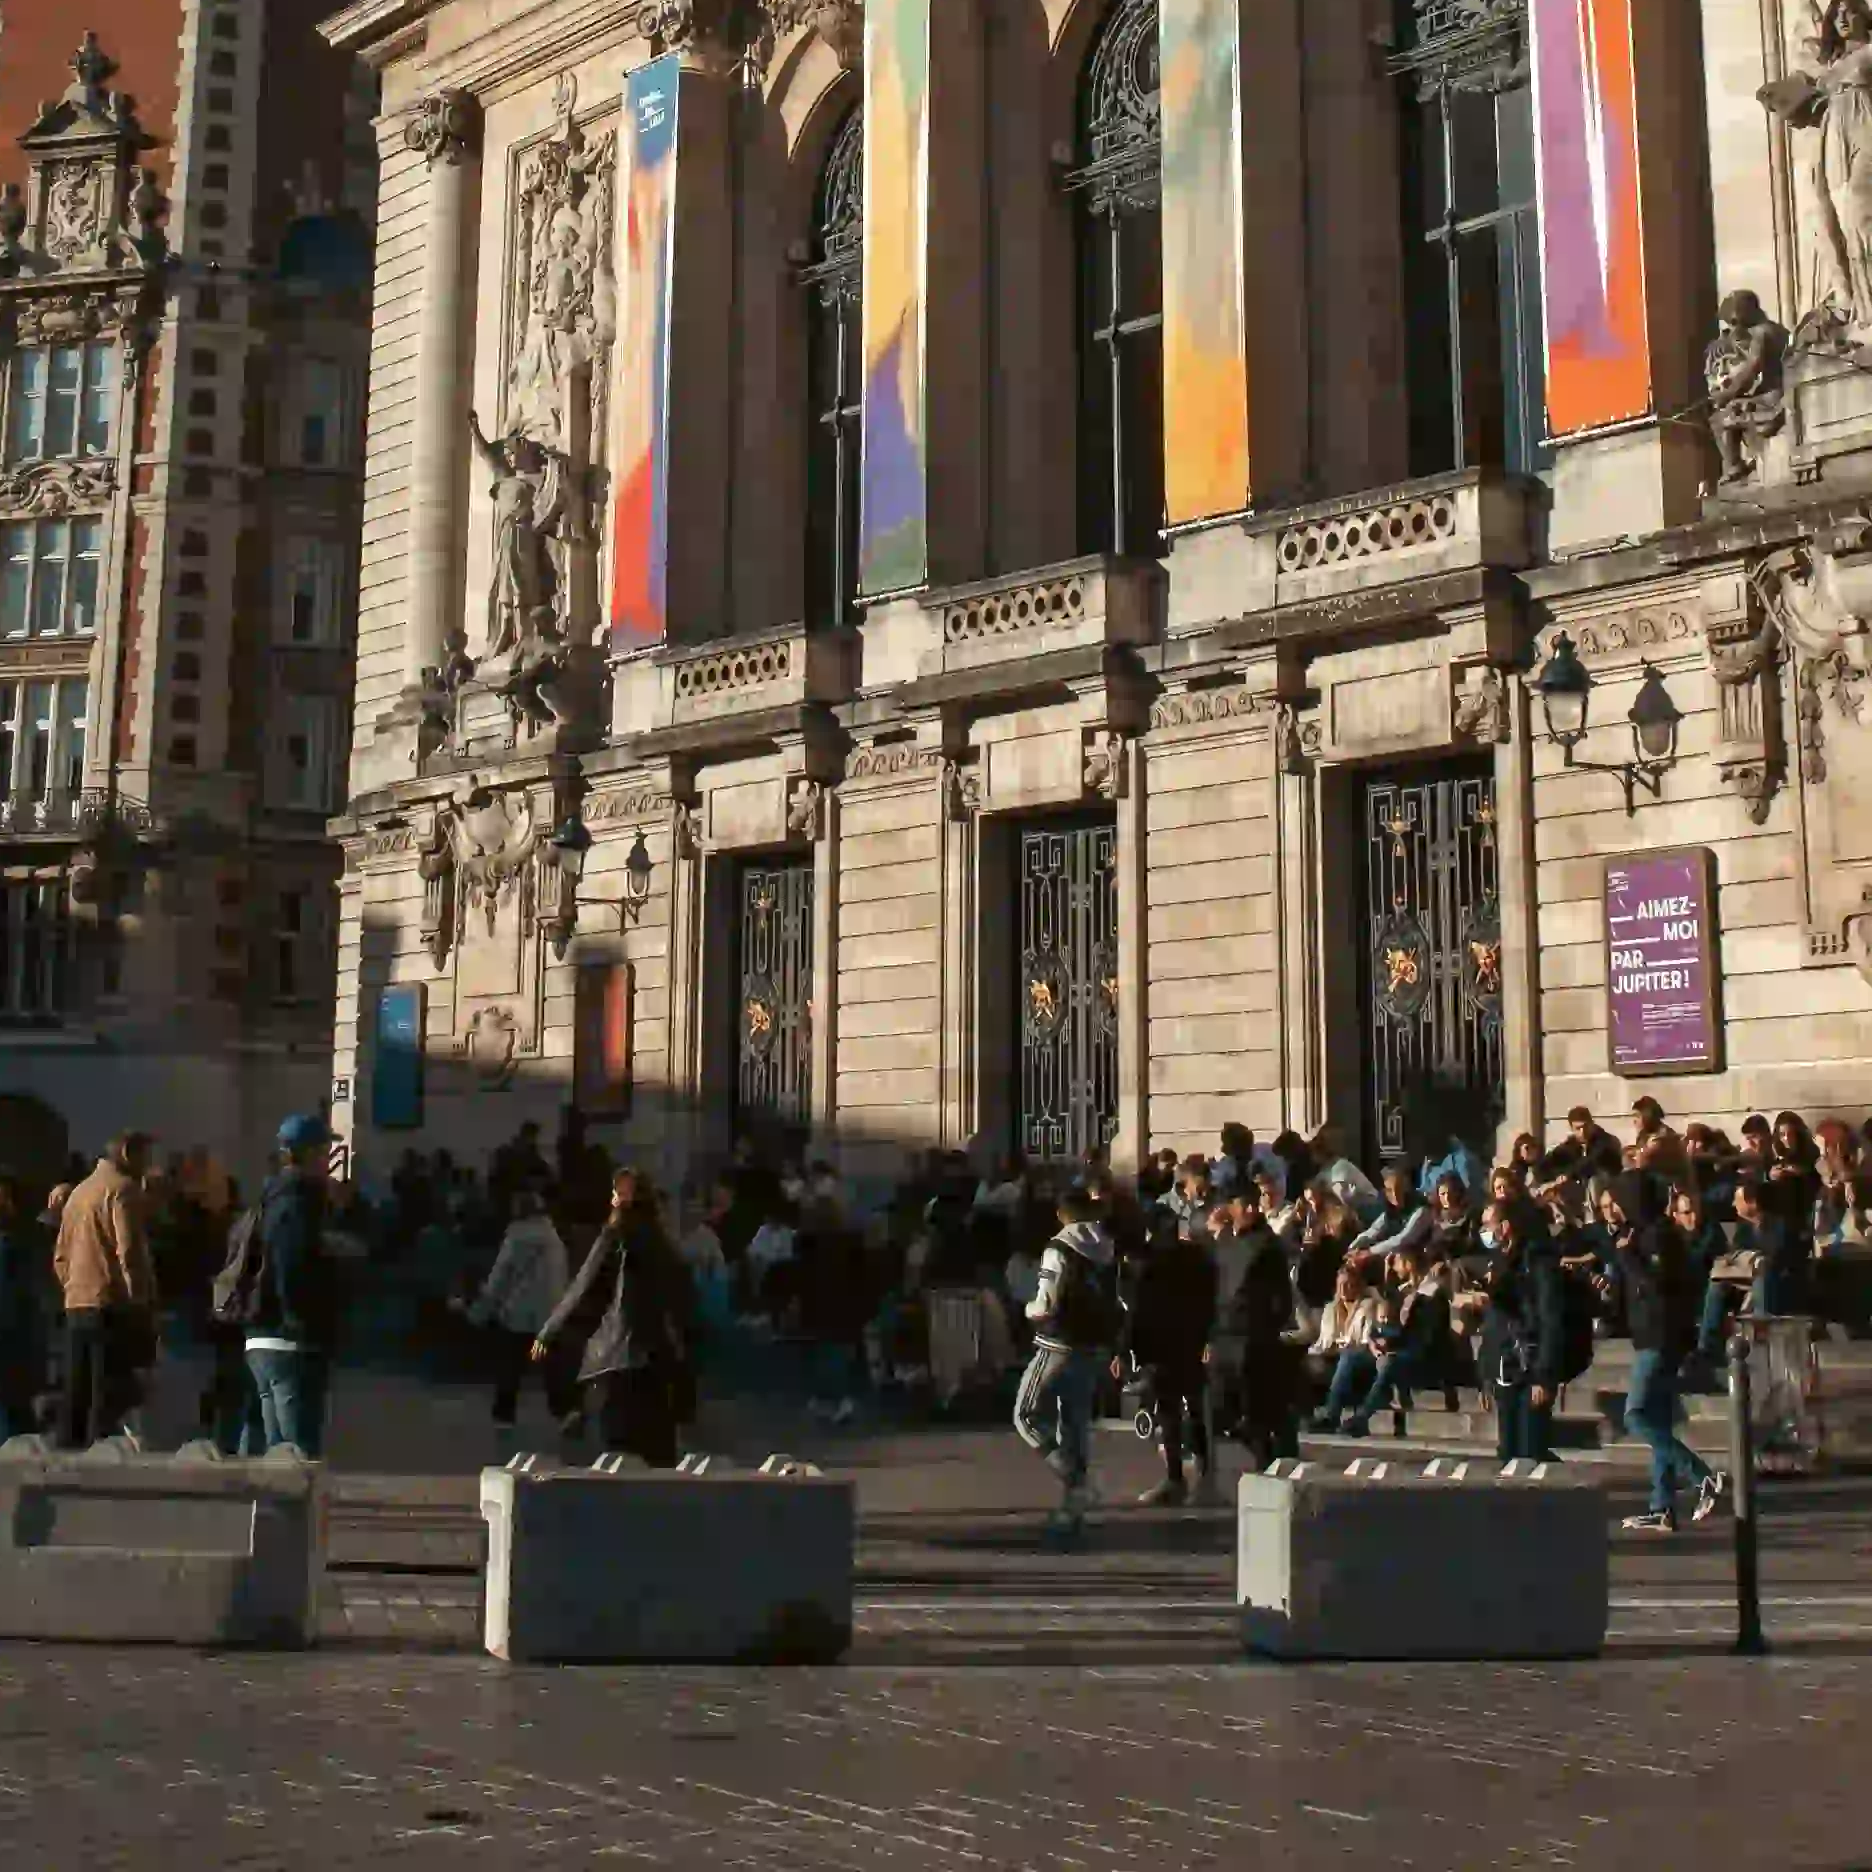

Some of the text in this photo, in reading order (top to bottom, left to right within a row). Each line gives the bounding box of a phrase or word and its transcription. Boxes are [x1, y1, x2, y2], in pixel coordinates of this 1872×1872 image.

[1636, 895, 1698, 920] AIMEZ-
[1663, 919, 1698, 941] MOI
[1611, 949, 1644, 971] PAR
